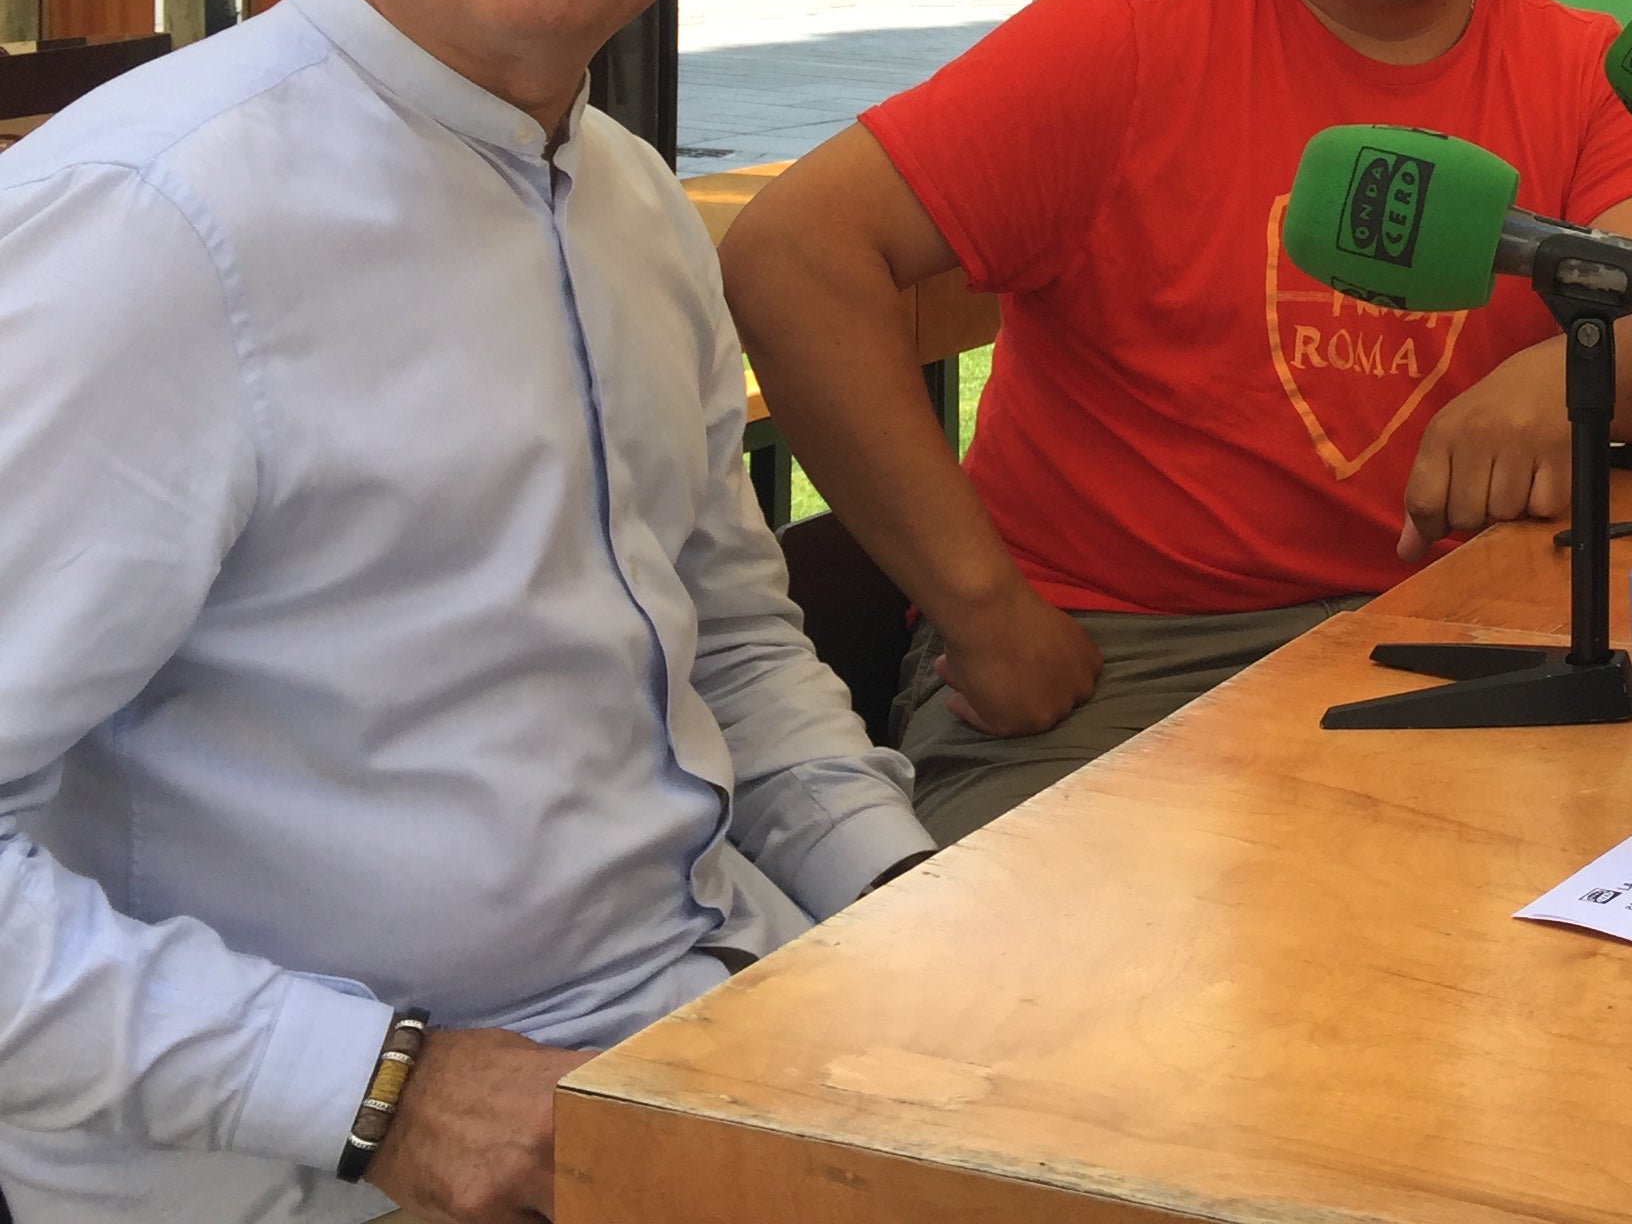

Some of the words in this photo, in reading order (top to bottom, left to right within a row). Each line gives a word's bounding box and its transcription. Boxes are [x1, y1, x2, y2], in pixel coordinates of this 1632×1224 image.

[1354, 164, 1386, 242] ONDA
[1384, 171, 1416, 245] CERO
[1290, 325, 1422, 379] ROMA
